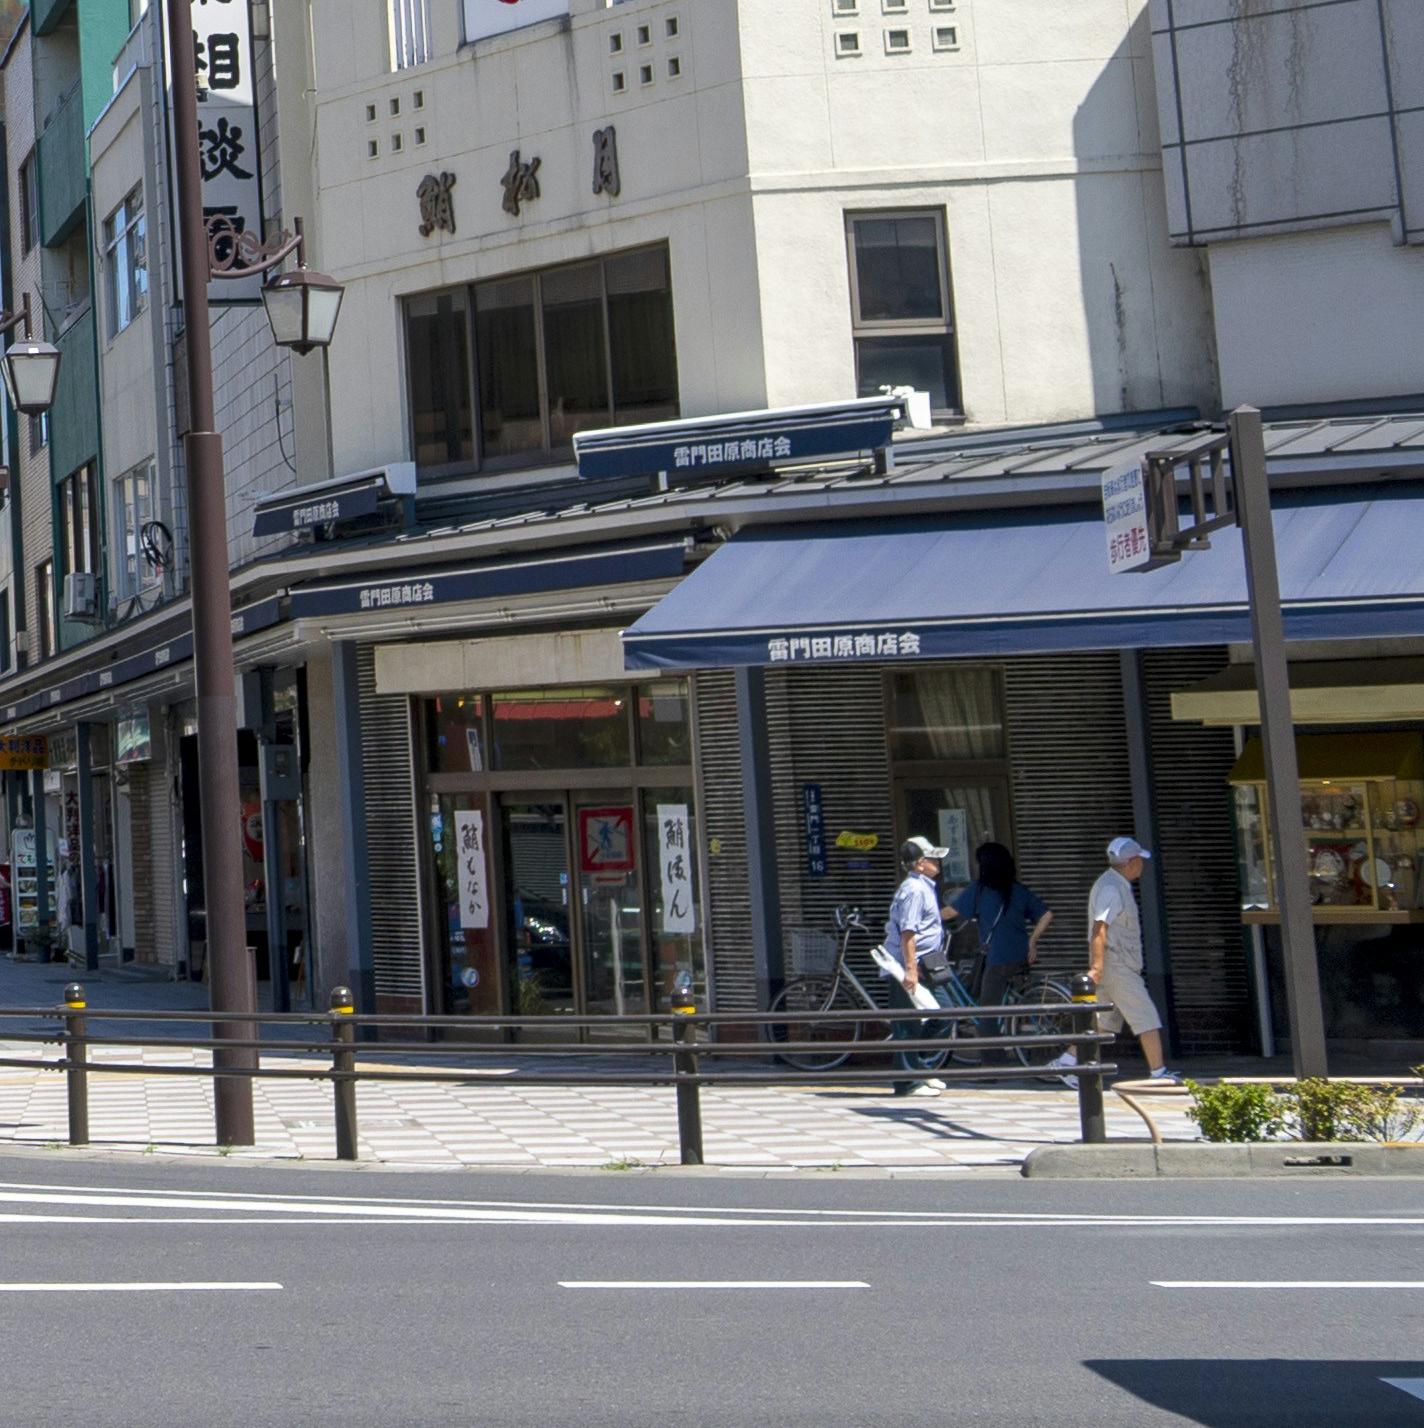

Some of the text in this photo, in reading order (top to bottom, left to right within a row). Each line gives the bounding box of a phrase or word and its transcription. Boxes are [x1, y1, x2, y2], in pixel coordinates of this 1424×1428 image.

[673, 436, 792, 469] 雷門田原商店会
[359, 582, 434, 608] 雷門田原商店会
[768, 632, 921, 661] 雷門田原商店会
